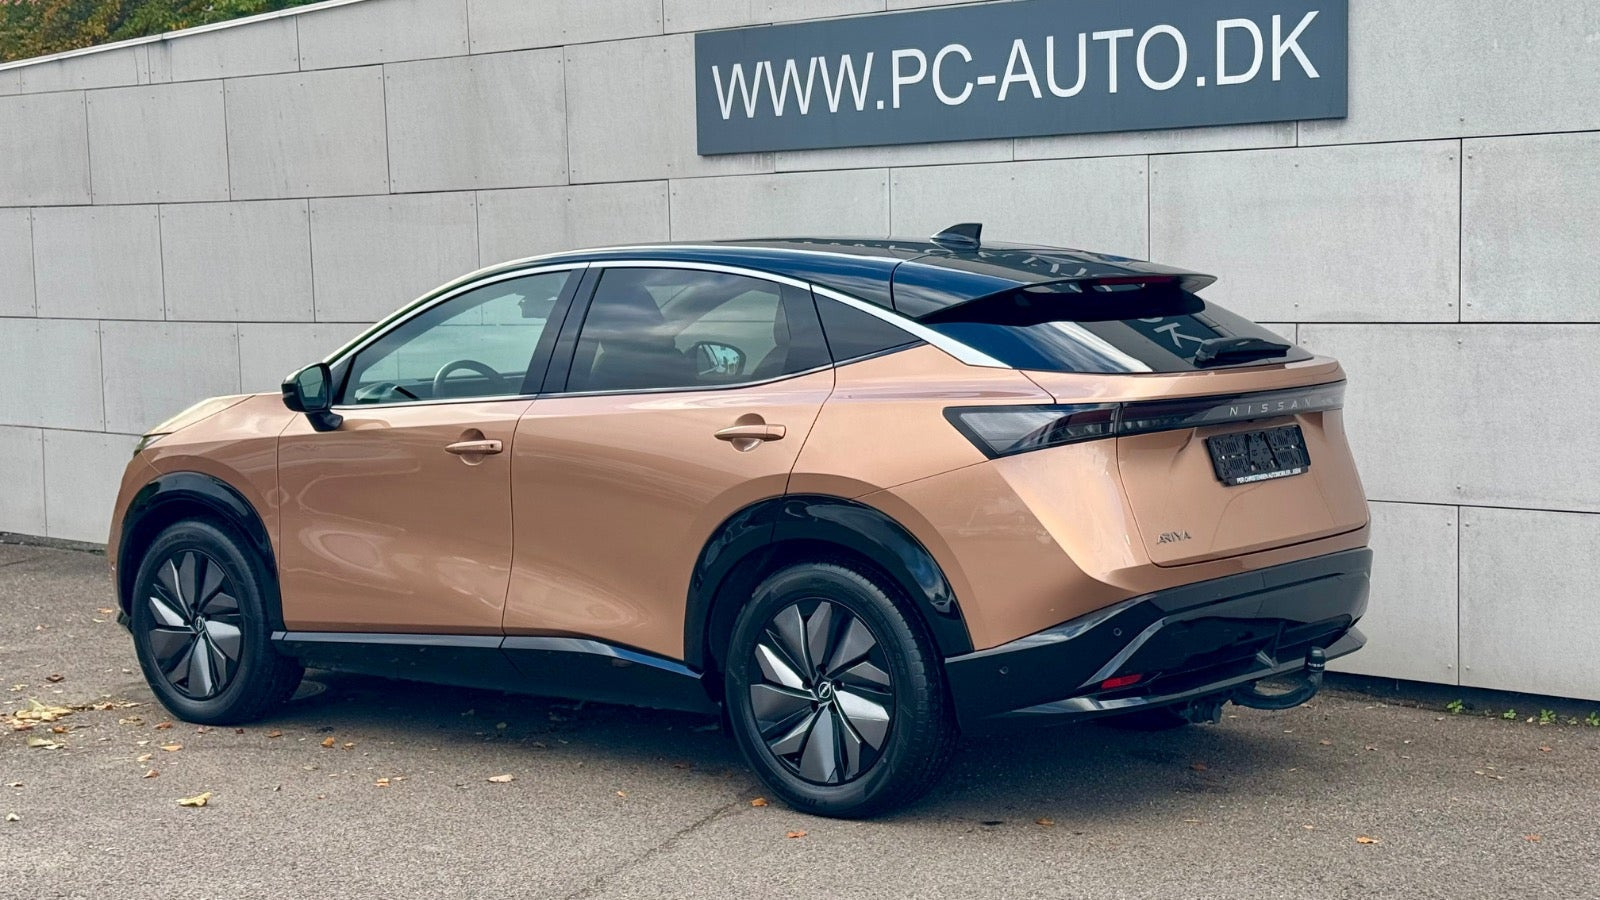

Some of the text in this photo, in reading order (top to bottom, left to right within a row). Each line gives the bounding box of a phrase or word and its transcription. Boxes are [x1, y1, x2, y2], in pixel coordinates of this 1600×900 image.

[711, 10, 1322, 120] WWW.PC-AUTO.DK
[1229, 400, 1312, 417] NISSAN
[1156, 530, 1192, 545] ARIYA
